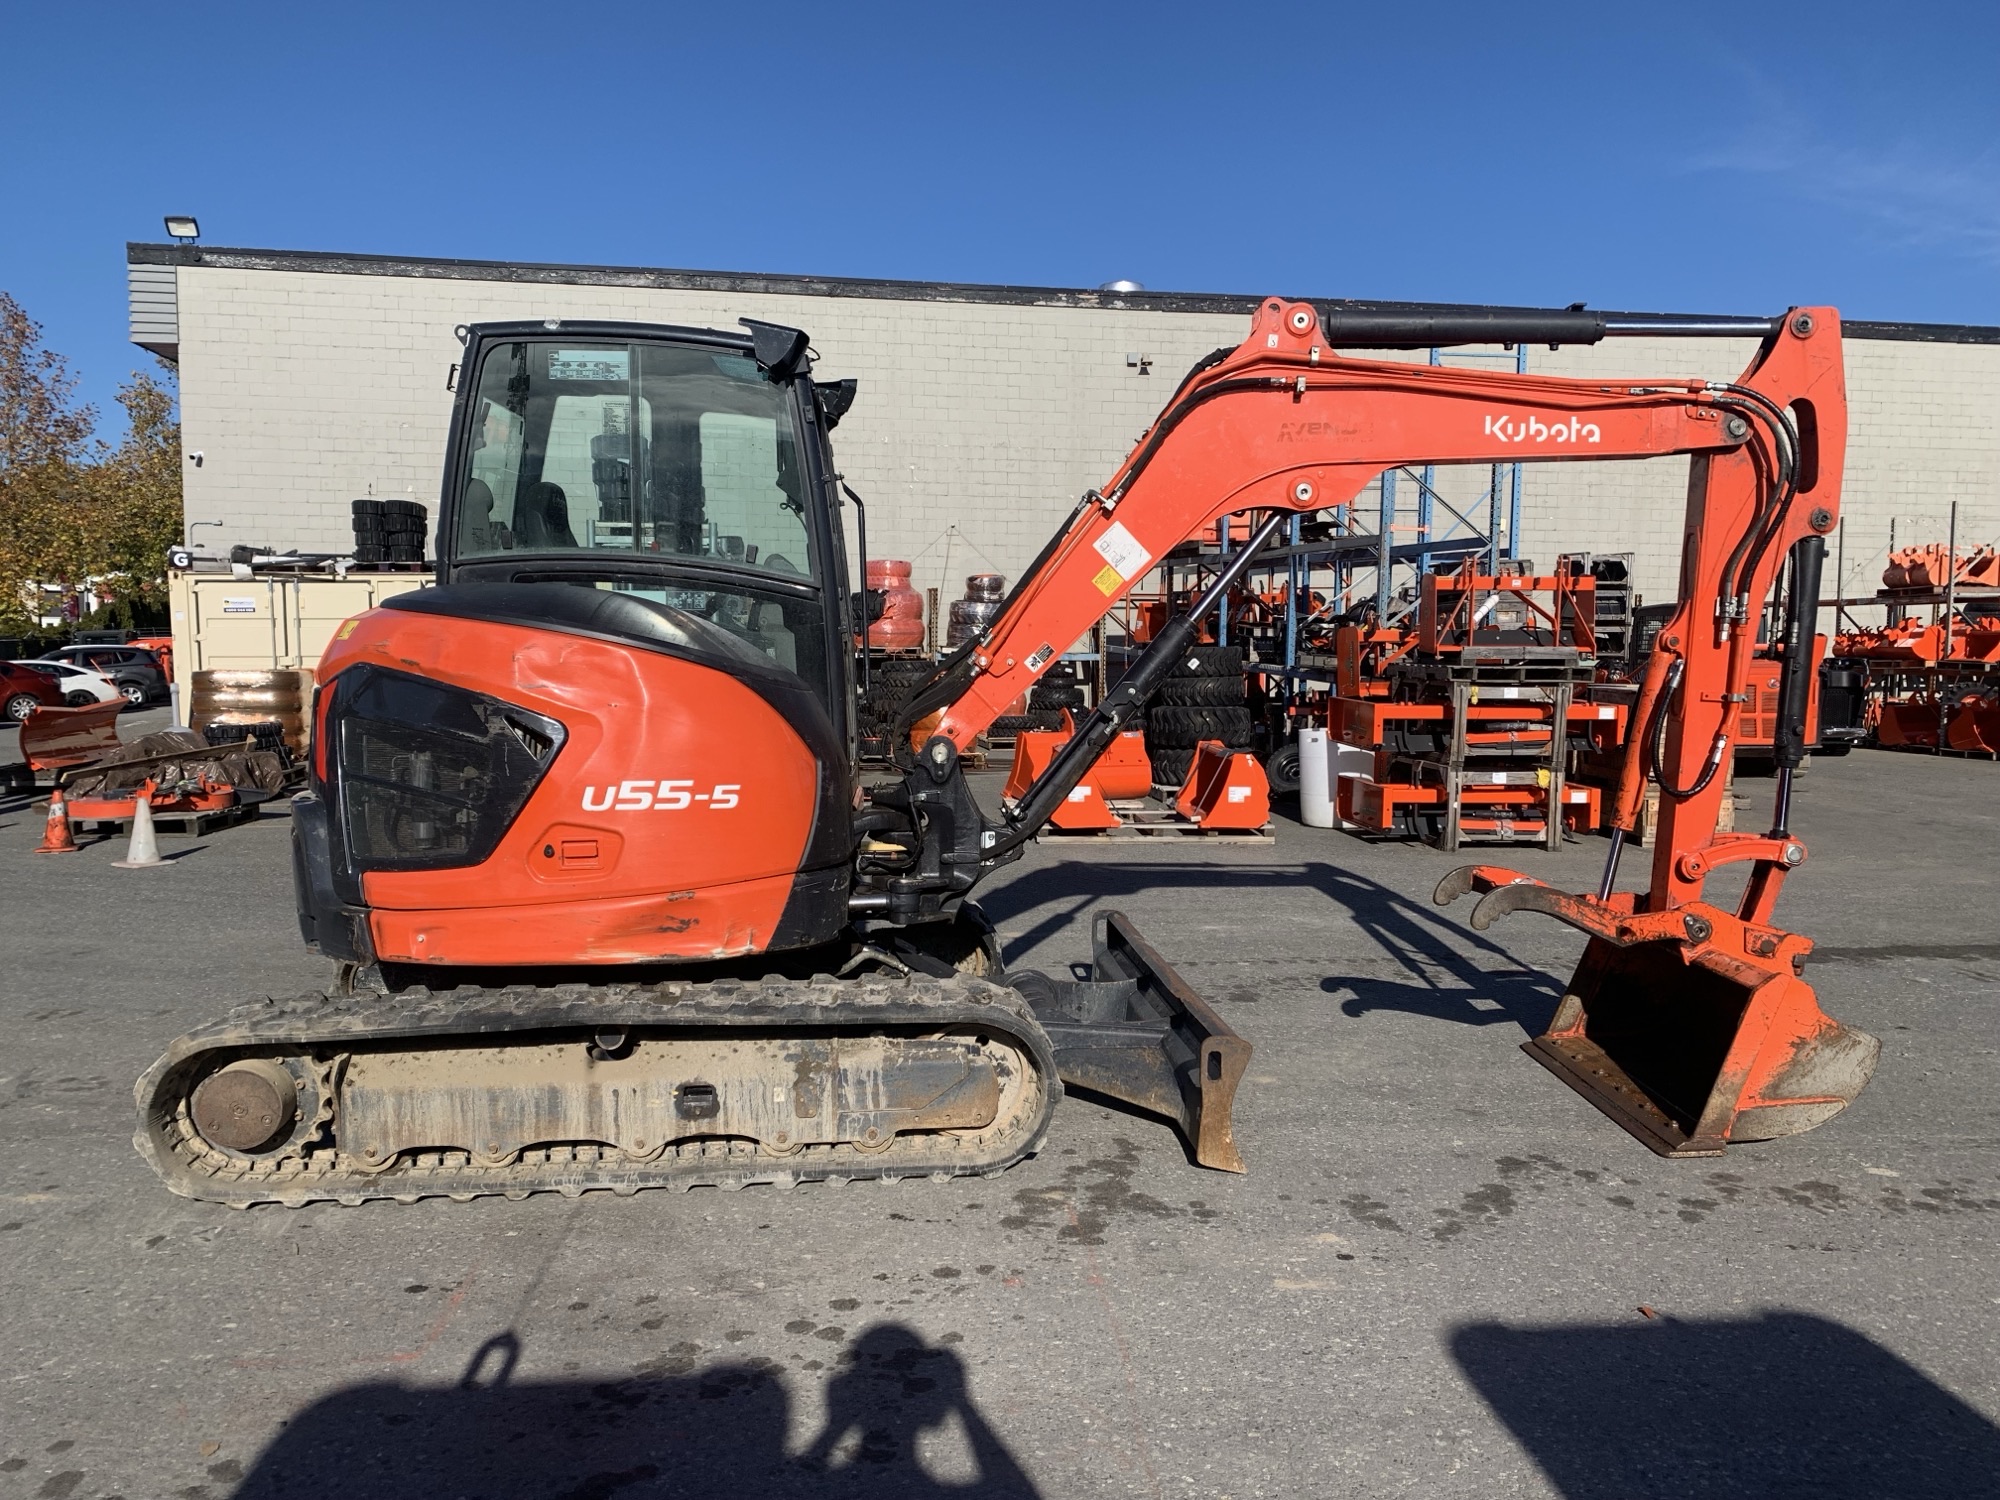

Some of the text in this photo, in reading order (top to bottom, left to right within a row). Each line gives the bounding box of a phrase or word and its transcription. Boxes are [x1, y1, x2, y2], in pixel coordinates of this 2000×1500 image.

[1484, 415, 1601, 443] Kubota
[173, 553, 189, 567] G
[581, 779, 742, 812] U55-5
